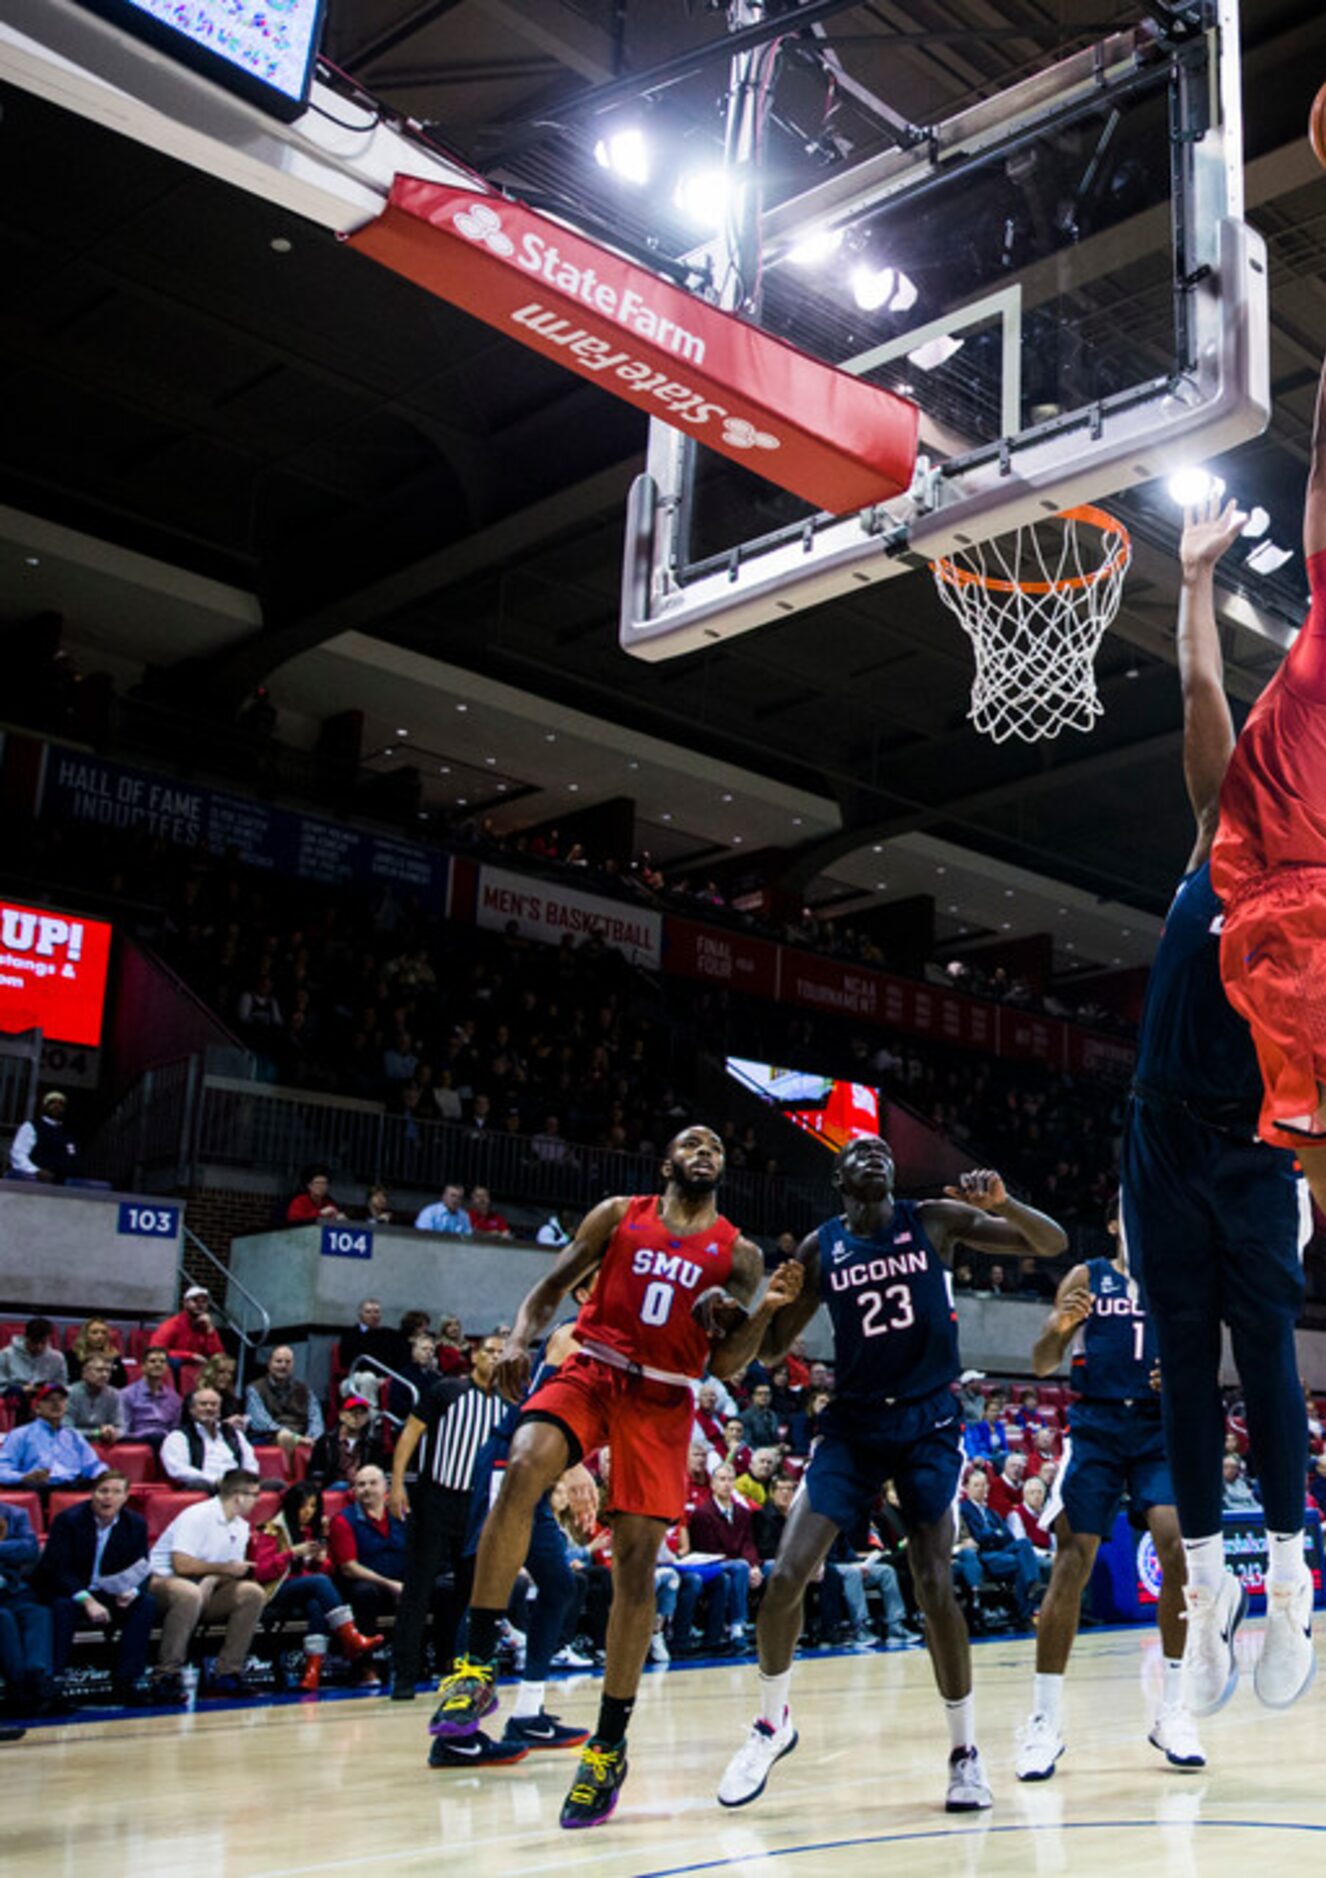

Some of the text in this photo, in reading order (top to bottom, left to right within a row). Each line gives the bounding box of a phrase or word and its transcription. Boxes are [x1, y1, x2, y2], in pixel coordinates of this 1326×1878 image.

[517, 232, 706, 365] StateFarm
[511, 303, 726, 425] StateFarm
[58, 760, 204, 821] HALL OF FAME
[484, 885, 540, 921] MEN'S
[2, 908, 84, 962] UP!
[696, 934, 733, 959] FINAL
[128, 1209, 171, 1231] 103
[328, 1232, 367, 1254] 104
[632, 1248, 703, 1289] SMU
[830, 1250, 928, 1291] UCONN
[640, 1281, 675, 1326] 0
[857, 1284, 915, 1337] 23
[1132, 1321, 1144, 1360] 1
